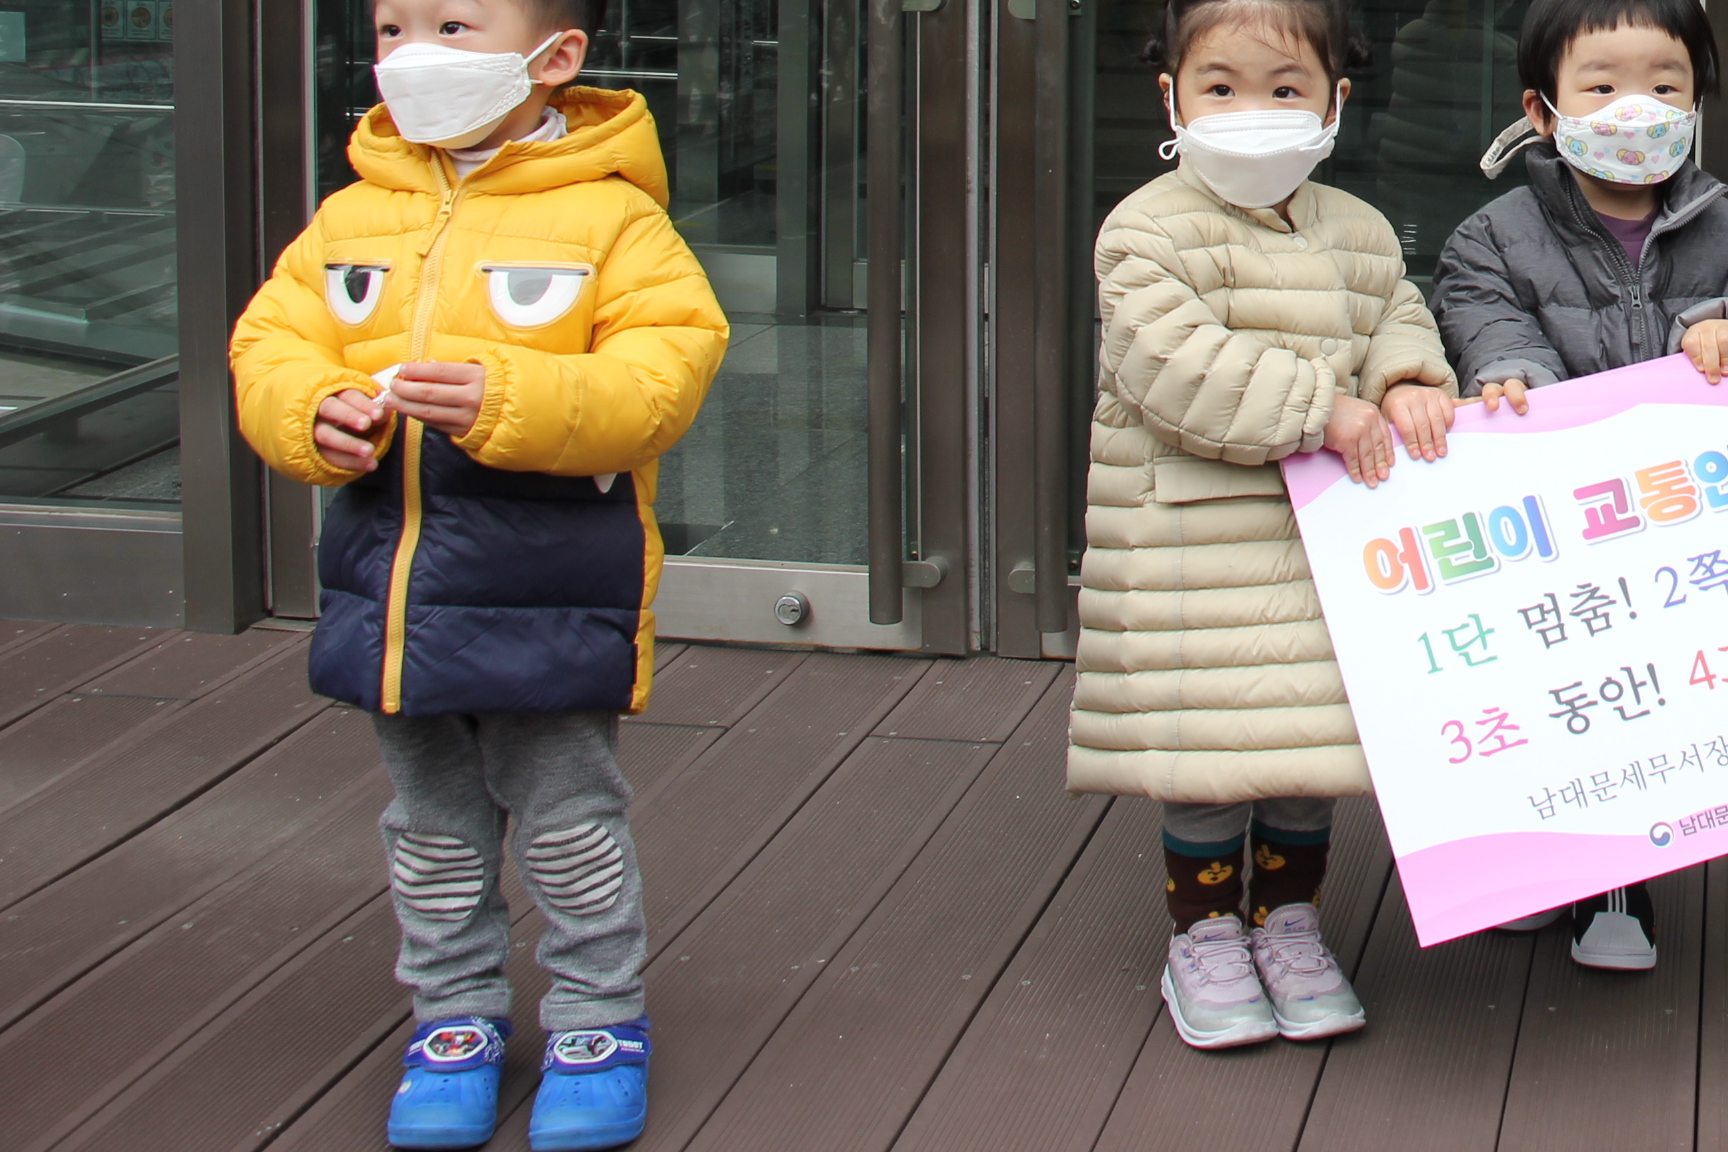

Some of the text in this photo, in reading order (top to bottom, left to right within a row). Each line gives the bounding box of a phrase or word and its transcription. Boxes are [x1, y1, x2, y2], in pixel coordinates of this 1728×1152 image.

[1363, 496, 1554, 590] 어린이
[1418, 614, 1497, 673] 1단
[1517, 577, 1637, 649] 멈춤!
[1441, 707, 1528, 764] 3초
[1548, 663, 1666, 735] 동안!
